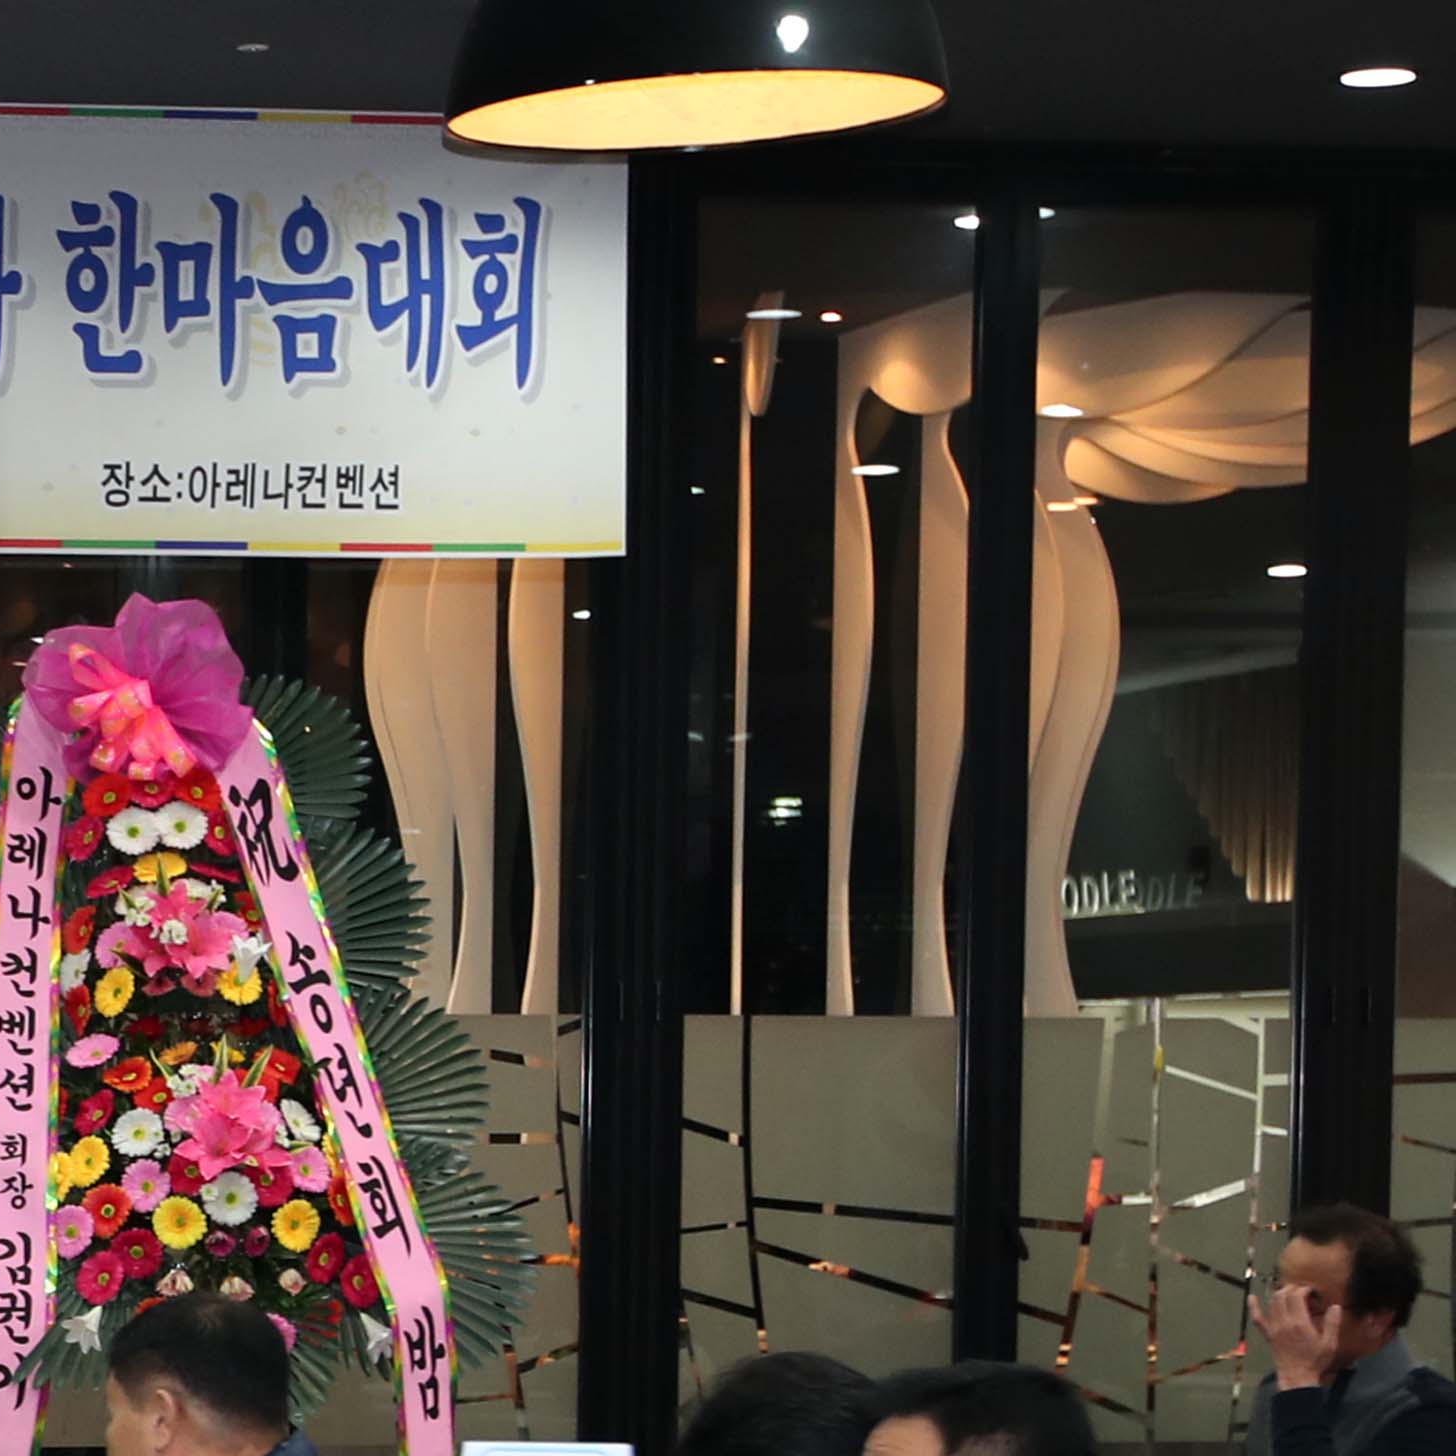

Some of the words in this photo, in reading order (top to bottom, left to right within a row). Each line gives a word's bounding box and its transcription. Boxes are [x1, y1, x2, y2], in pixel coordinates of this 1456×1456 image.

[55, 190, 544, 388] 한마음대회
[100, 461, 400, 511] 장소:아레나컨벤션
[227, 777, 300, 886] 祝
[403, 1305, 446, 1422] 밤
